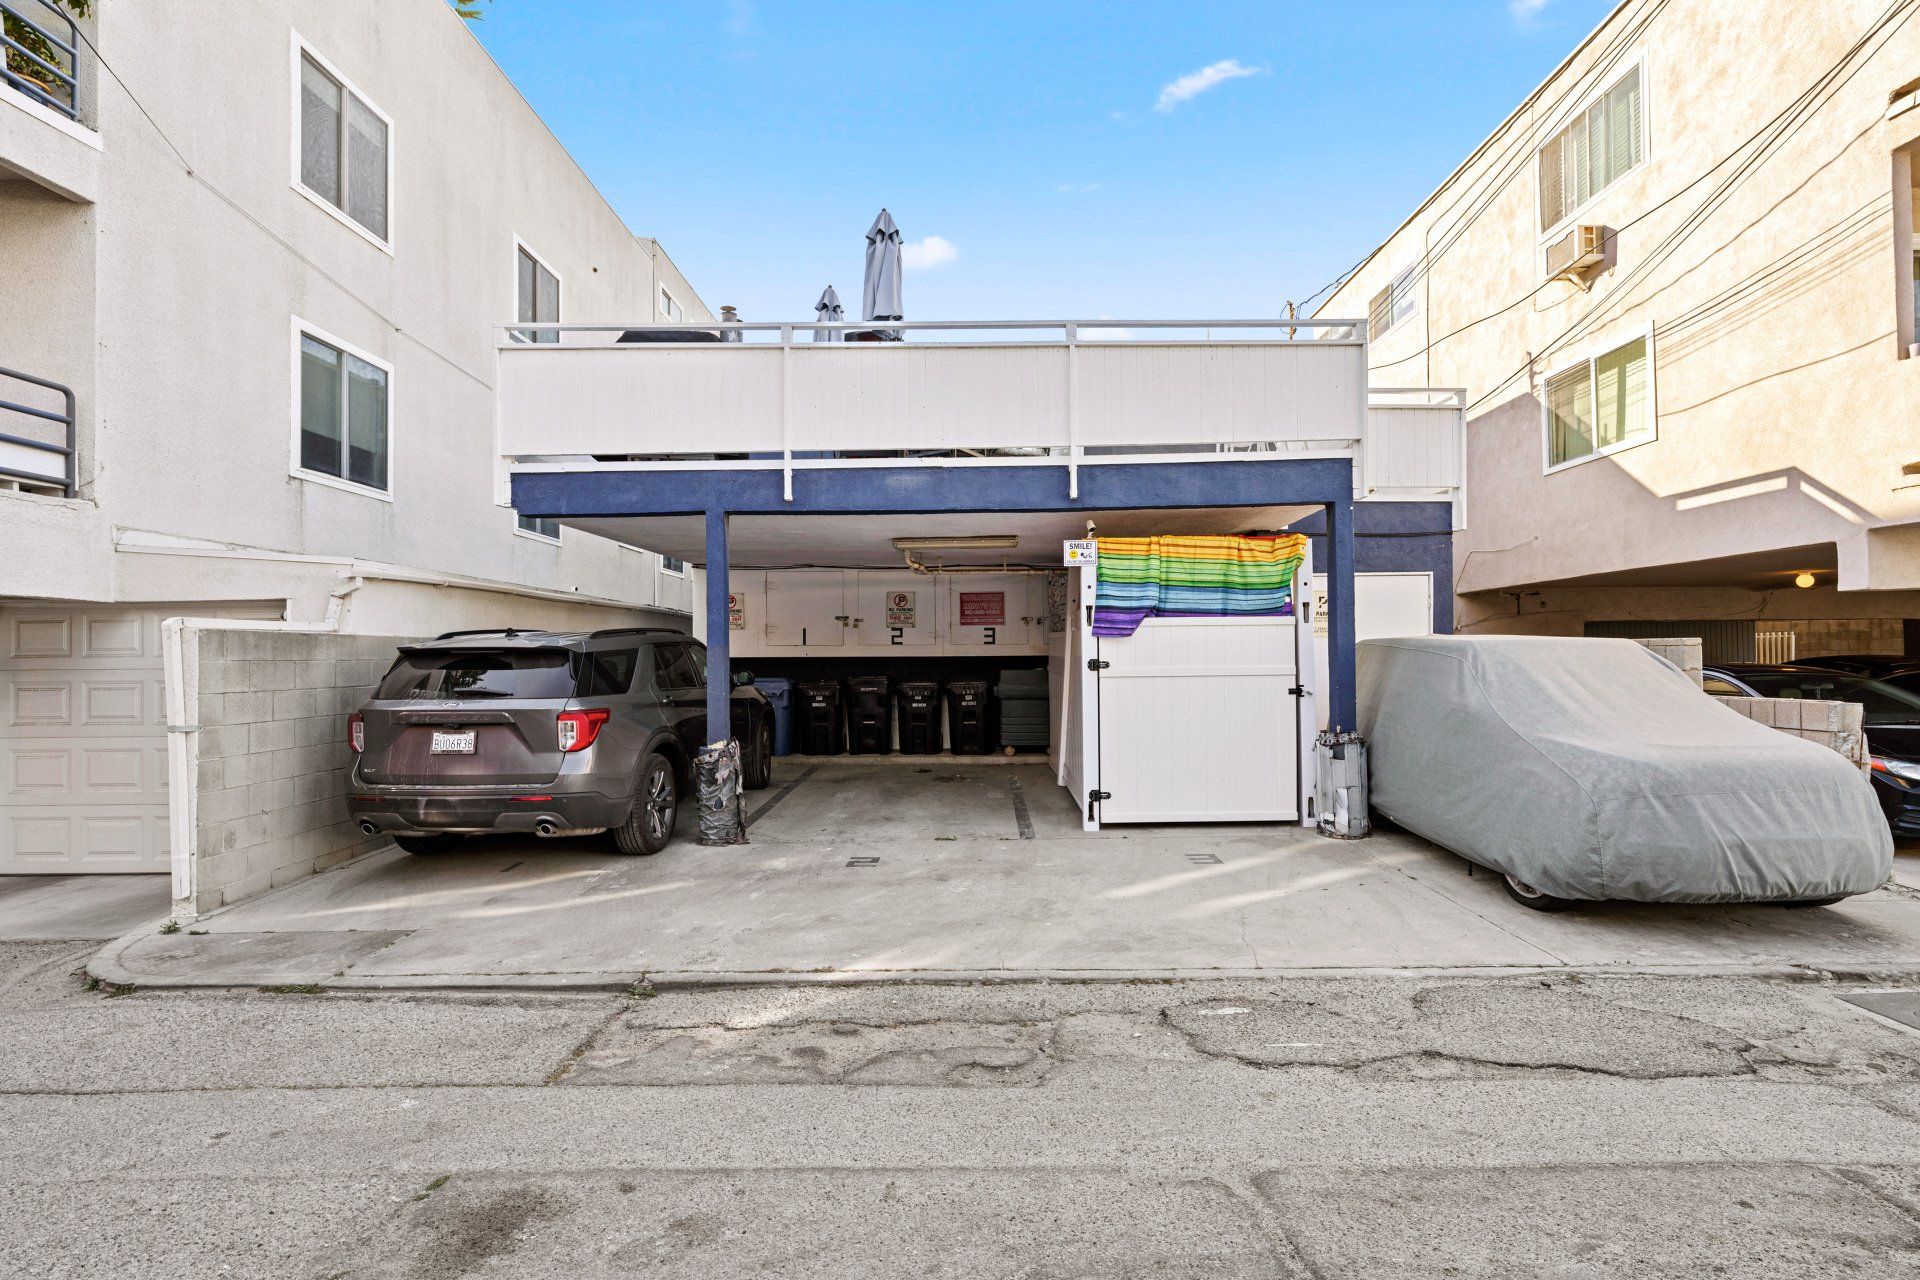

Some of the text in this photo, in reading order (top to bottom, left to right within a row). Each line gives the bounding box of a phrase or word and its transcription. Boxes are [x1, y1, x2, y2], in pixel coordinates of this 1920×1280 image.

[803, 628, 806, 646] 1
[891, 627, 903, 645] 2
[983, 627, 996, 645] 3
